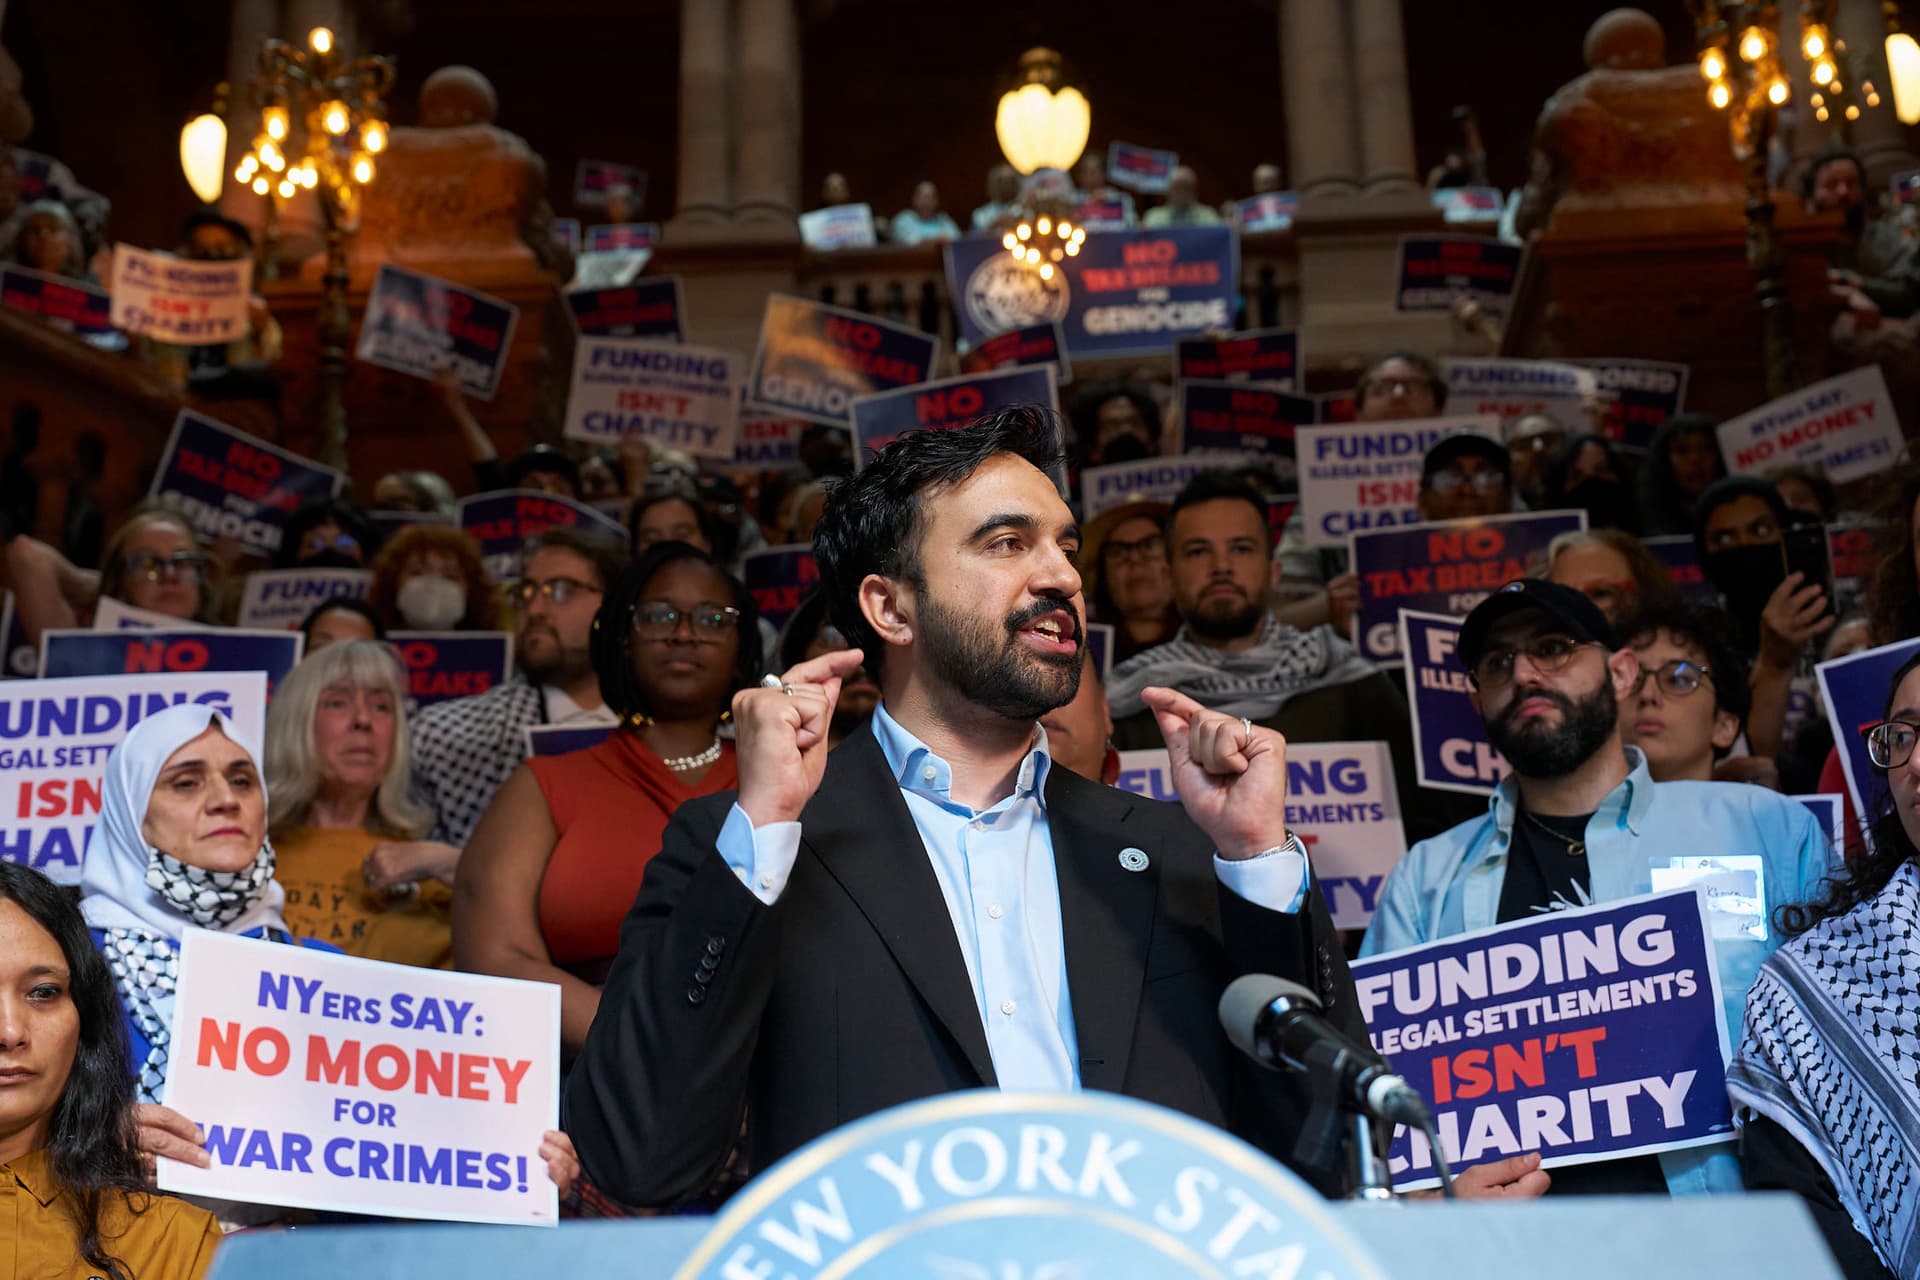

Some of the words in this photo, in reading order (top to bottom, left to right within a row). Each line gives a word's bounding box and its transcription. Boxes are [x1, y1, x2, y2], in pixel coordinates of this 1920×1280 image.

[1122, 238, 1178, 265] NO
[825, 313, 884, 350] NO
[591, 348, 729, 382] FUNDING
[915, 384, 985, 425] NO
[1735, 438, 1775, 471] NO
[1778, 400, 1877, 449] MONEY
[224, 438, 282, 481] NO
[1427, 526, 1505, 564] NO
[1364, 566, 1432, 600] TAX
[124, 639, 210, 674] NO
[1355, 914, 1676, 1024] FUNDING
[389, 992, 485, 1037] SAY:
[1465, 969, 1698, 1039] SETTLEMENTS
[196, 1017, 291, 1077] NO
[305, 1034, 532, 1105] MONEY
[1431, 1026, 1607, 1105] ISN'T
[333, 1098, 397, 1128] FOR
[196, 1122, 313, 1174] WAR
[323, 1137, 529, 1194] CRIMES!
[864, 1124, 1142, 1212] YORK
[1153, 1166, 1337, 1280] STA
